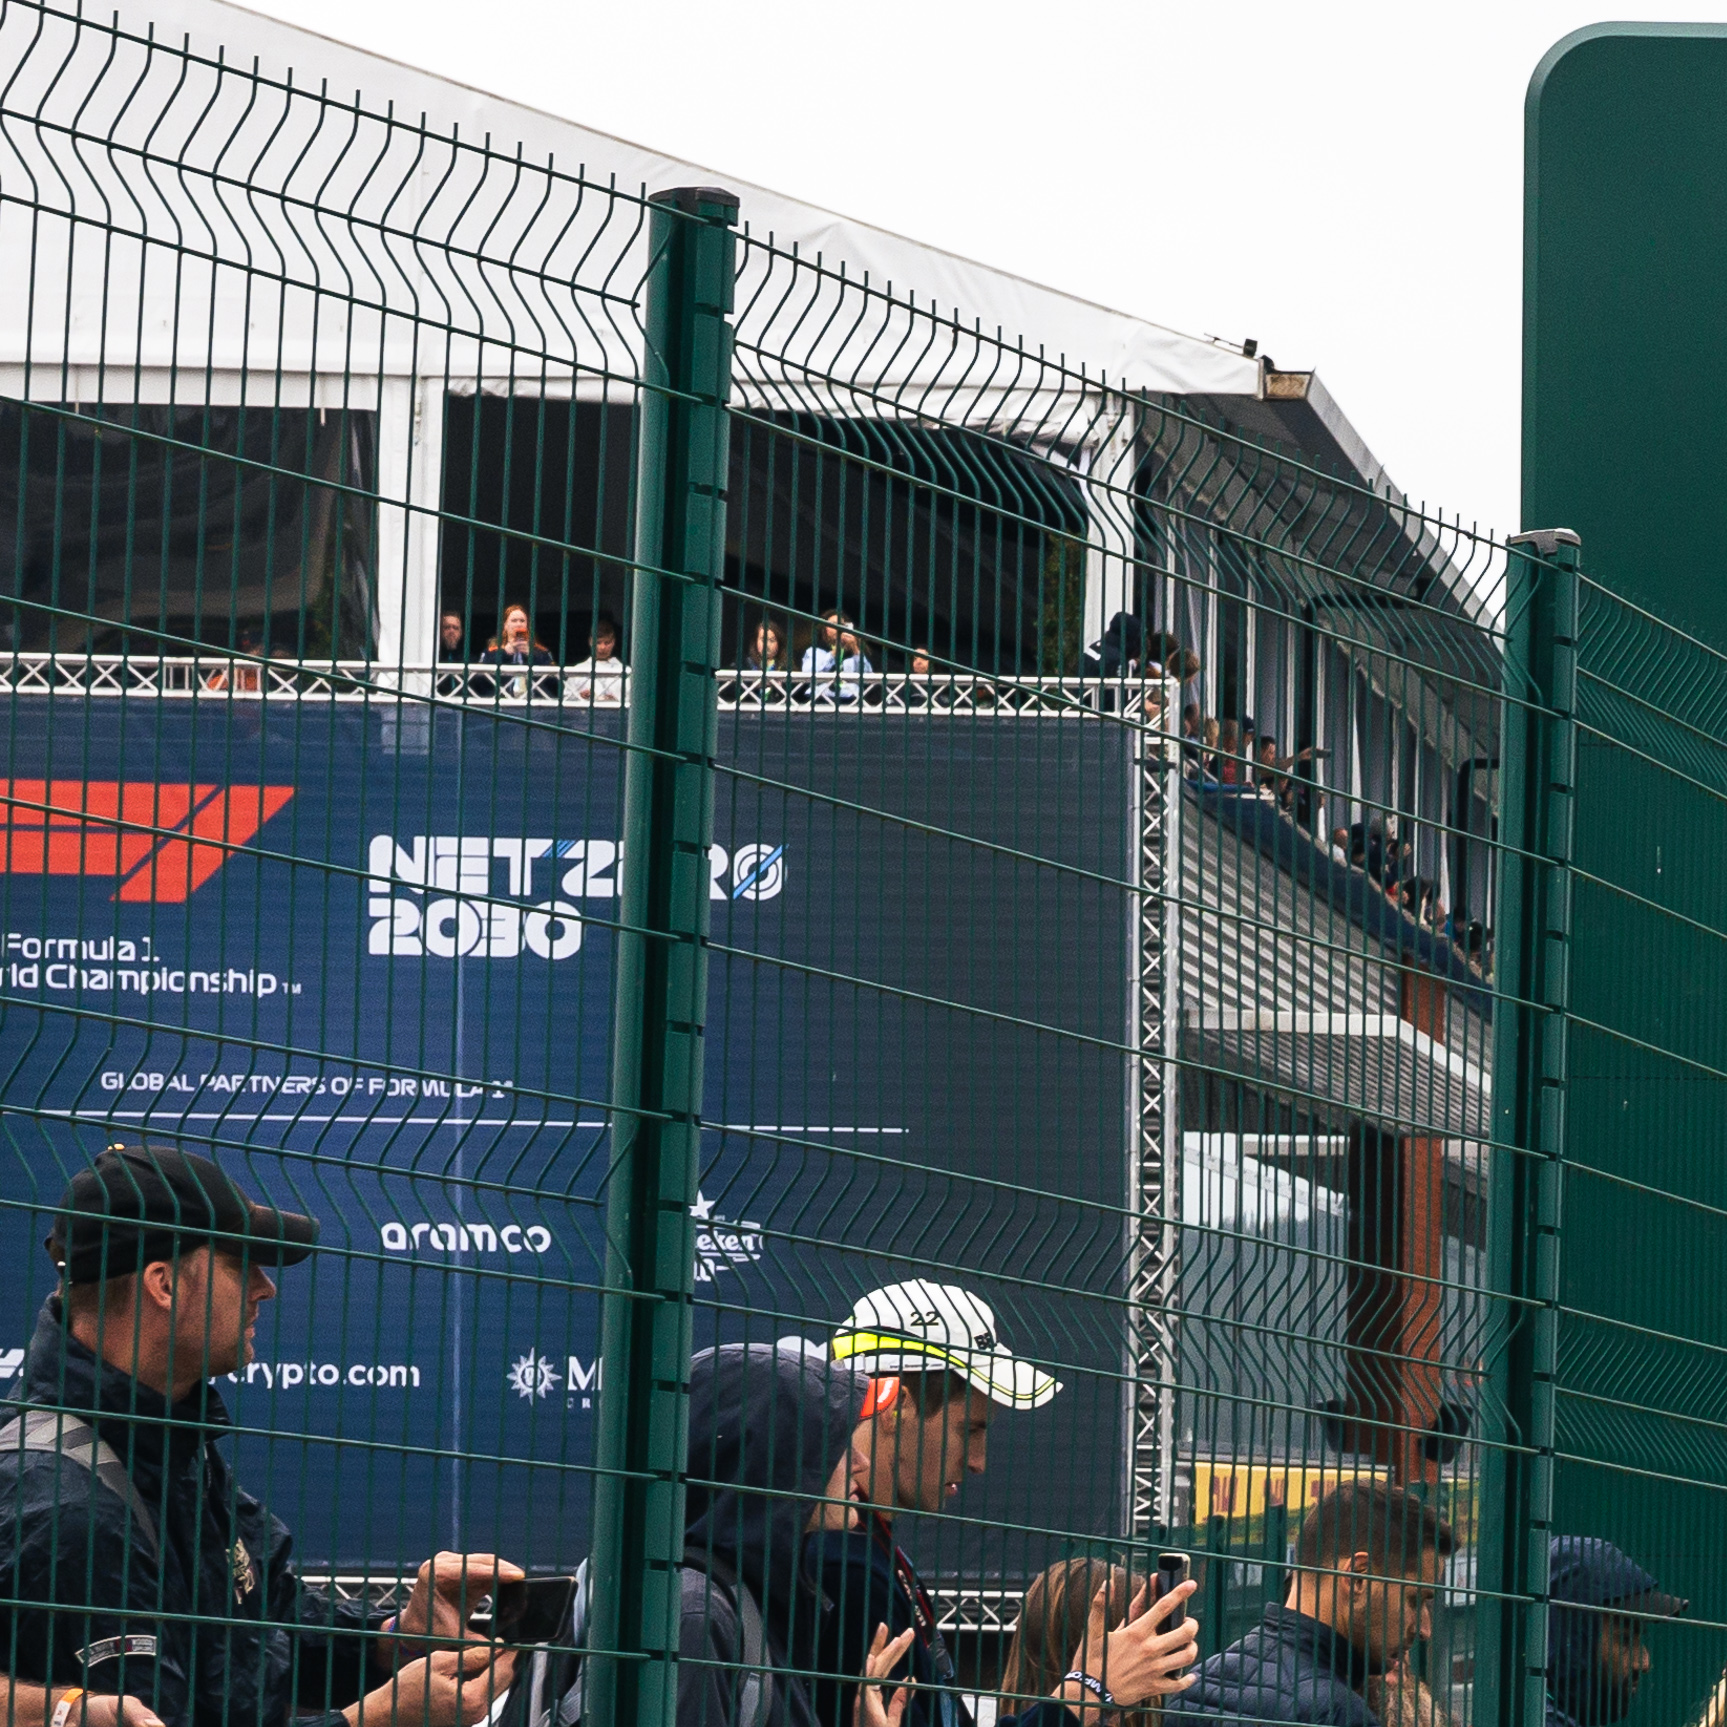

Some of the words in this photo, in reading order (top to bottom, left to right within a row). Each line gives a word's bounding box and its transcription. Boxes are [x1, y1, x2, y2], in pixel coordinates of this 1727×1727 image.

[368, 898, 582, 960] 2030
[101, 1071, 195, 1092] GLOBAL
[203, 1073, 327, 1095] PARTNERS
[380, 1222, 552, 1253] aramco
[909, 1310, 939, 1327] 22
